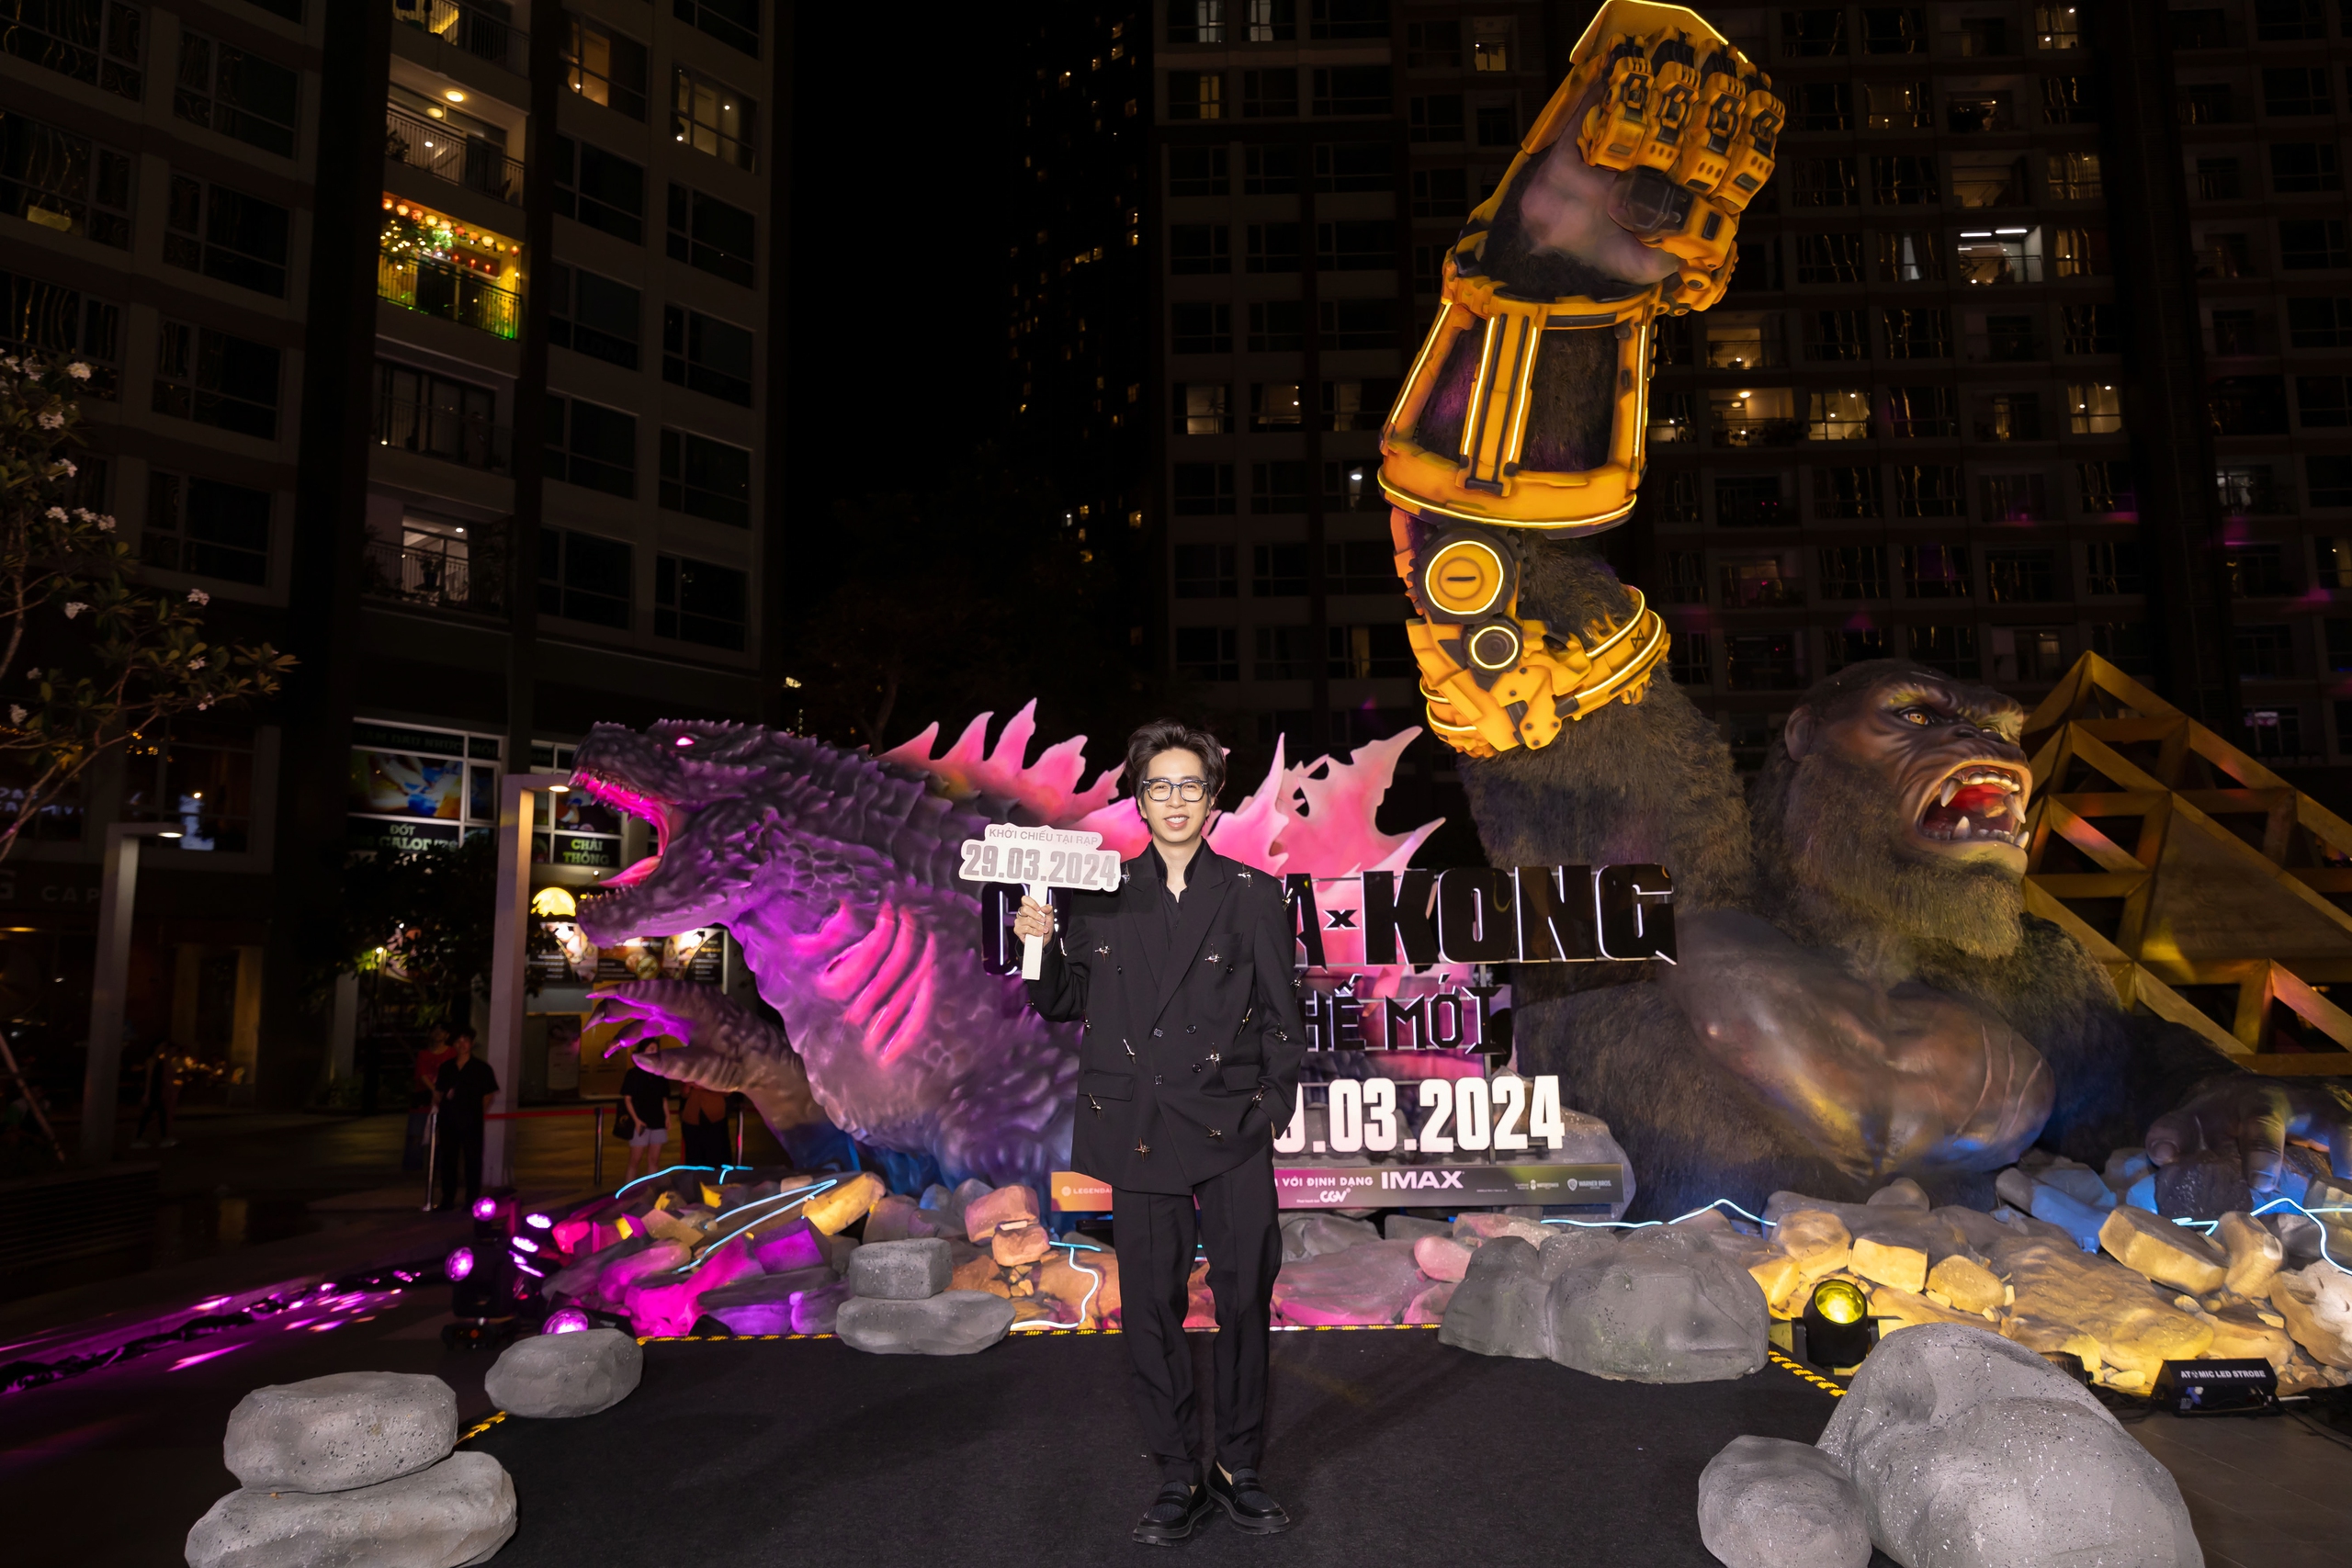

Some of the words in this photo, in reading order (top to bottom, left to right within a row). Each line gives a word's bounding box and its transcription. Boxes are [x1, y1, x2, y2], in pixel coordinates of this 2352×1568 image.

[989, 827, 1017, 840] KHỞI
[1020, 829, 1054, 842] CHIẾU
[1056, 833, 1073, 844] TẠI
[1076, 835, 1098, 846] RẠP
[964, 843, 1117, 887] 29.03.2024
[1362, 863, 1678, 966] KONG
[1383, 973, 1507, 1055] MỚI
[1306, 1177, 1336, 1188] ĐỊNH
[1340, 1177, 1374, 1188] DẠNG
[1381, 1170, 1464, 1190] IMAX
[1319, 1190, 1348, 1202] CGV
[2214, 1370, 2232, 1379] LED
[2233, 1370, 2267, 1379] STROBE
